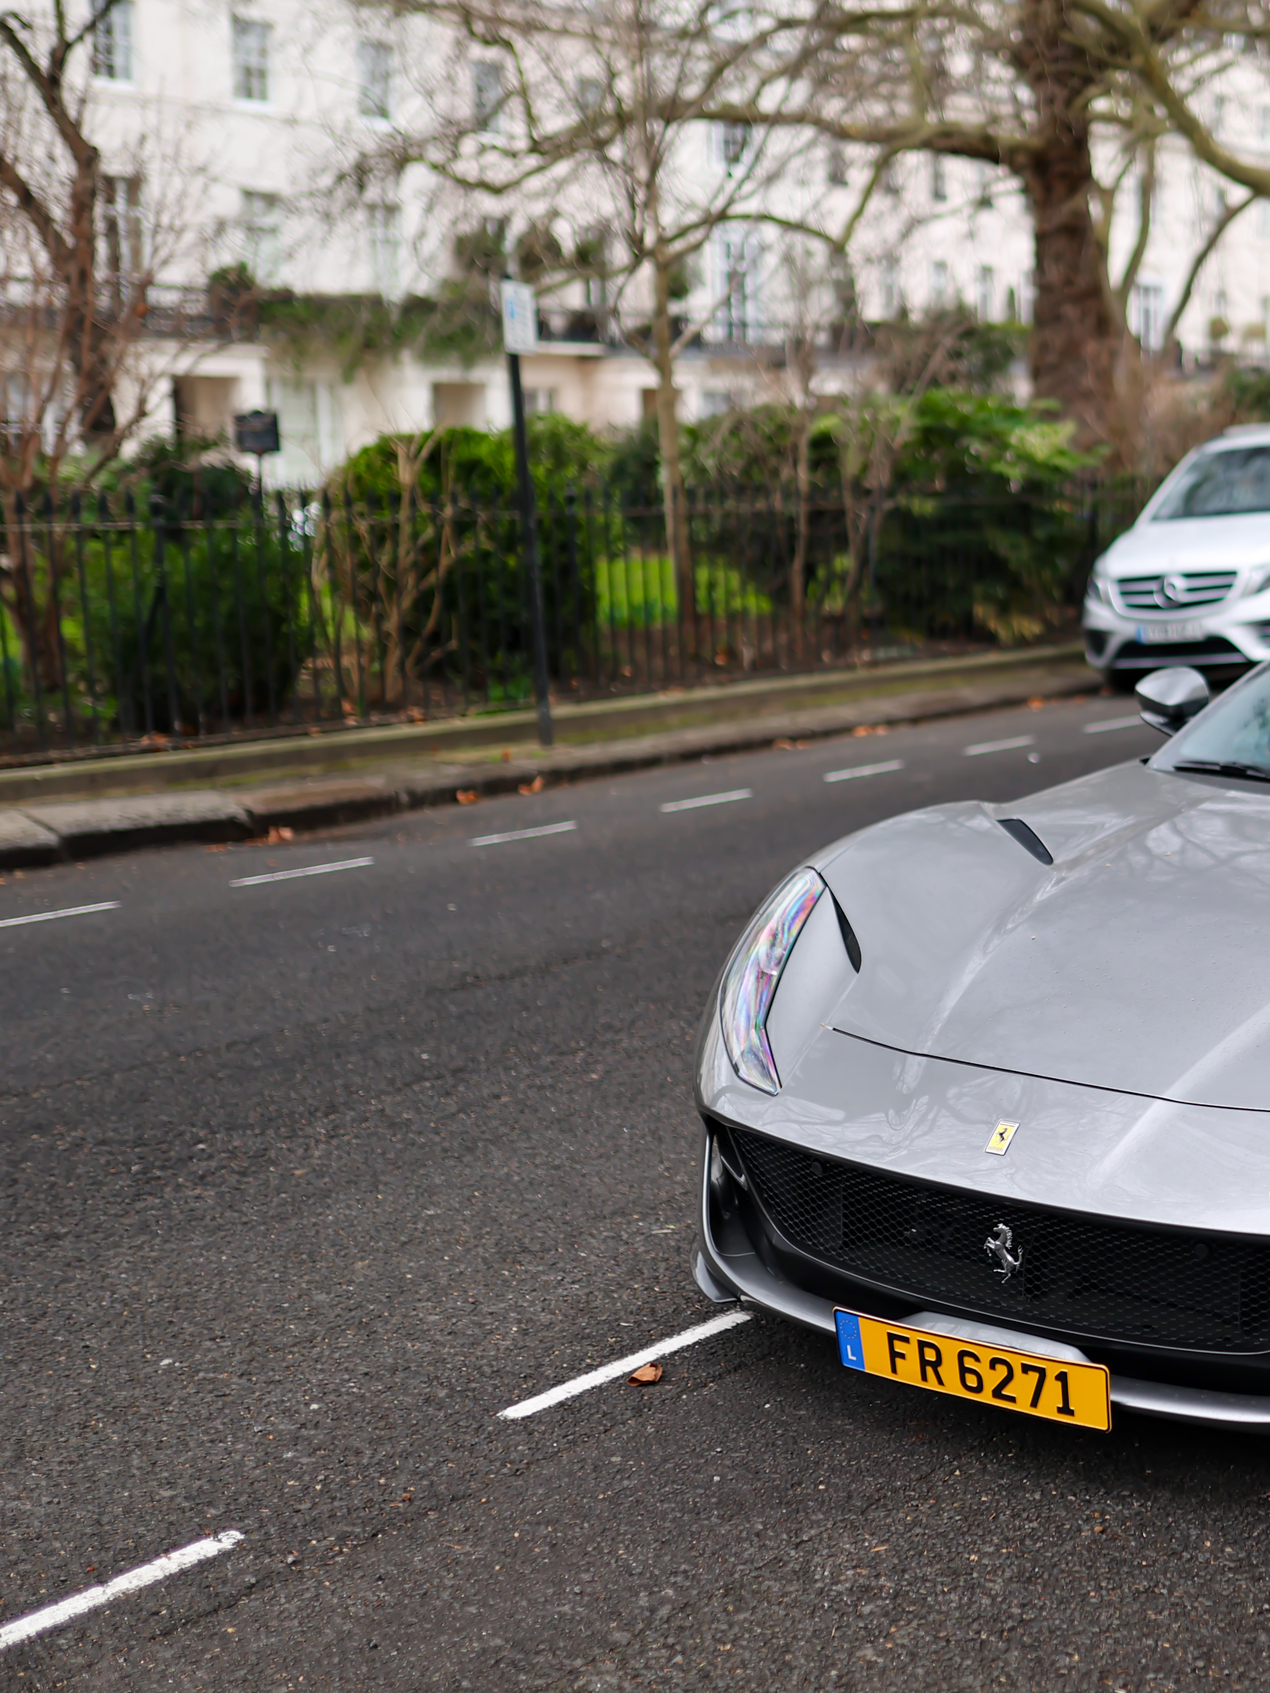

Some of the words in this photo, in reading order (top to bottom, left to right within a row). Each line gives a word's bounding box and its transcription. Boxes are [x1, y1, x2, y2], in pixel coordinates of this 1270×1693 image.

[846, 1344, 857, 1361] L
[886, 1330, 946, 1387] FR
[957, 1348, 1075, 1417] 6271
